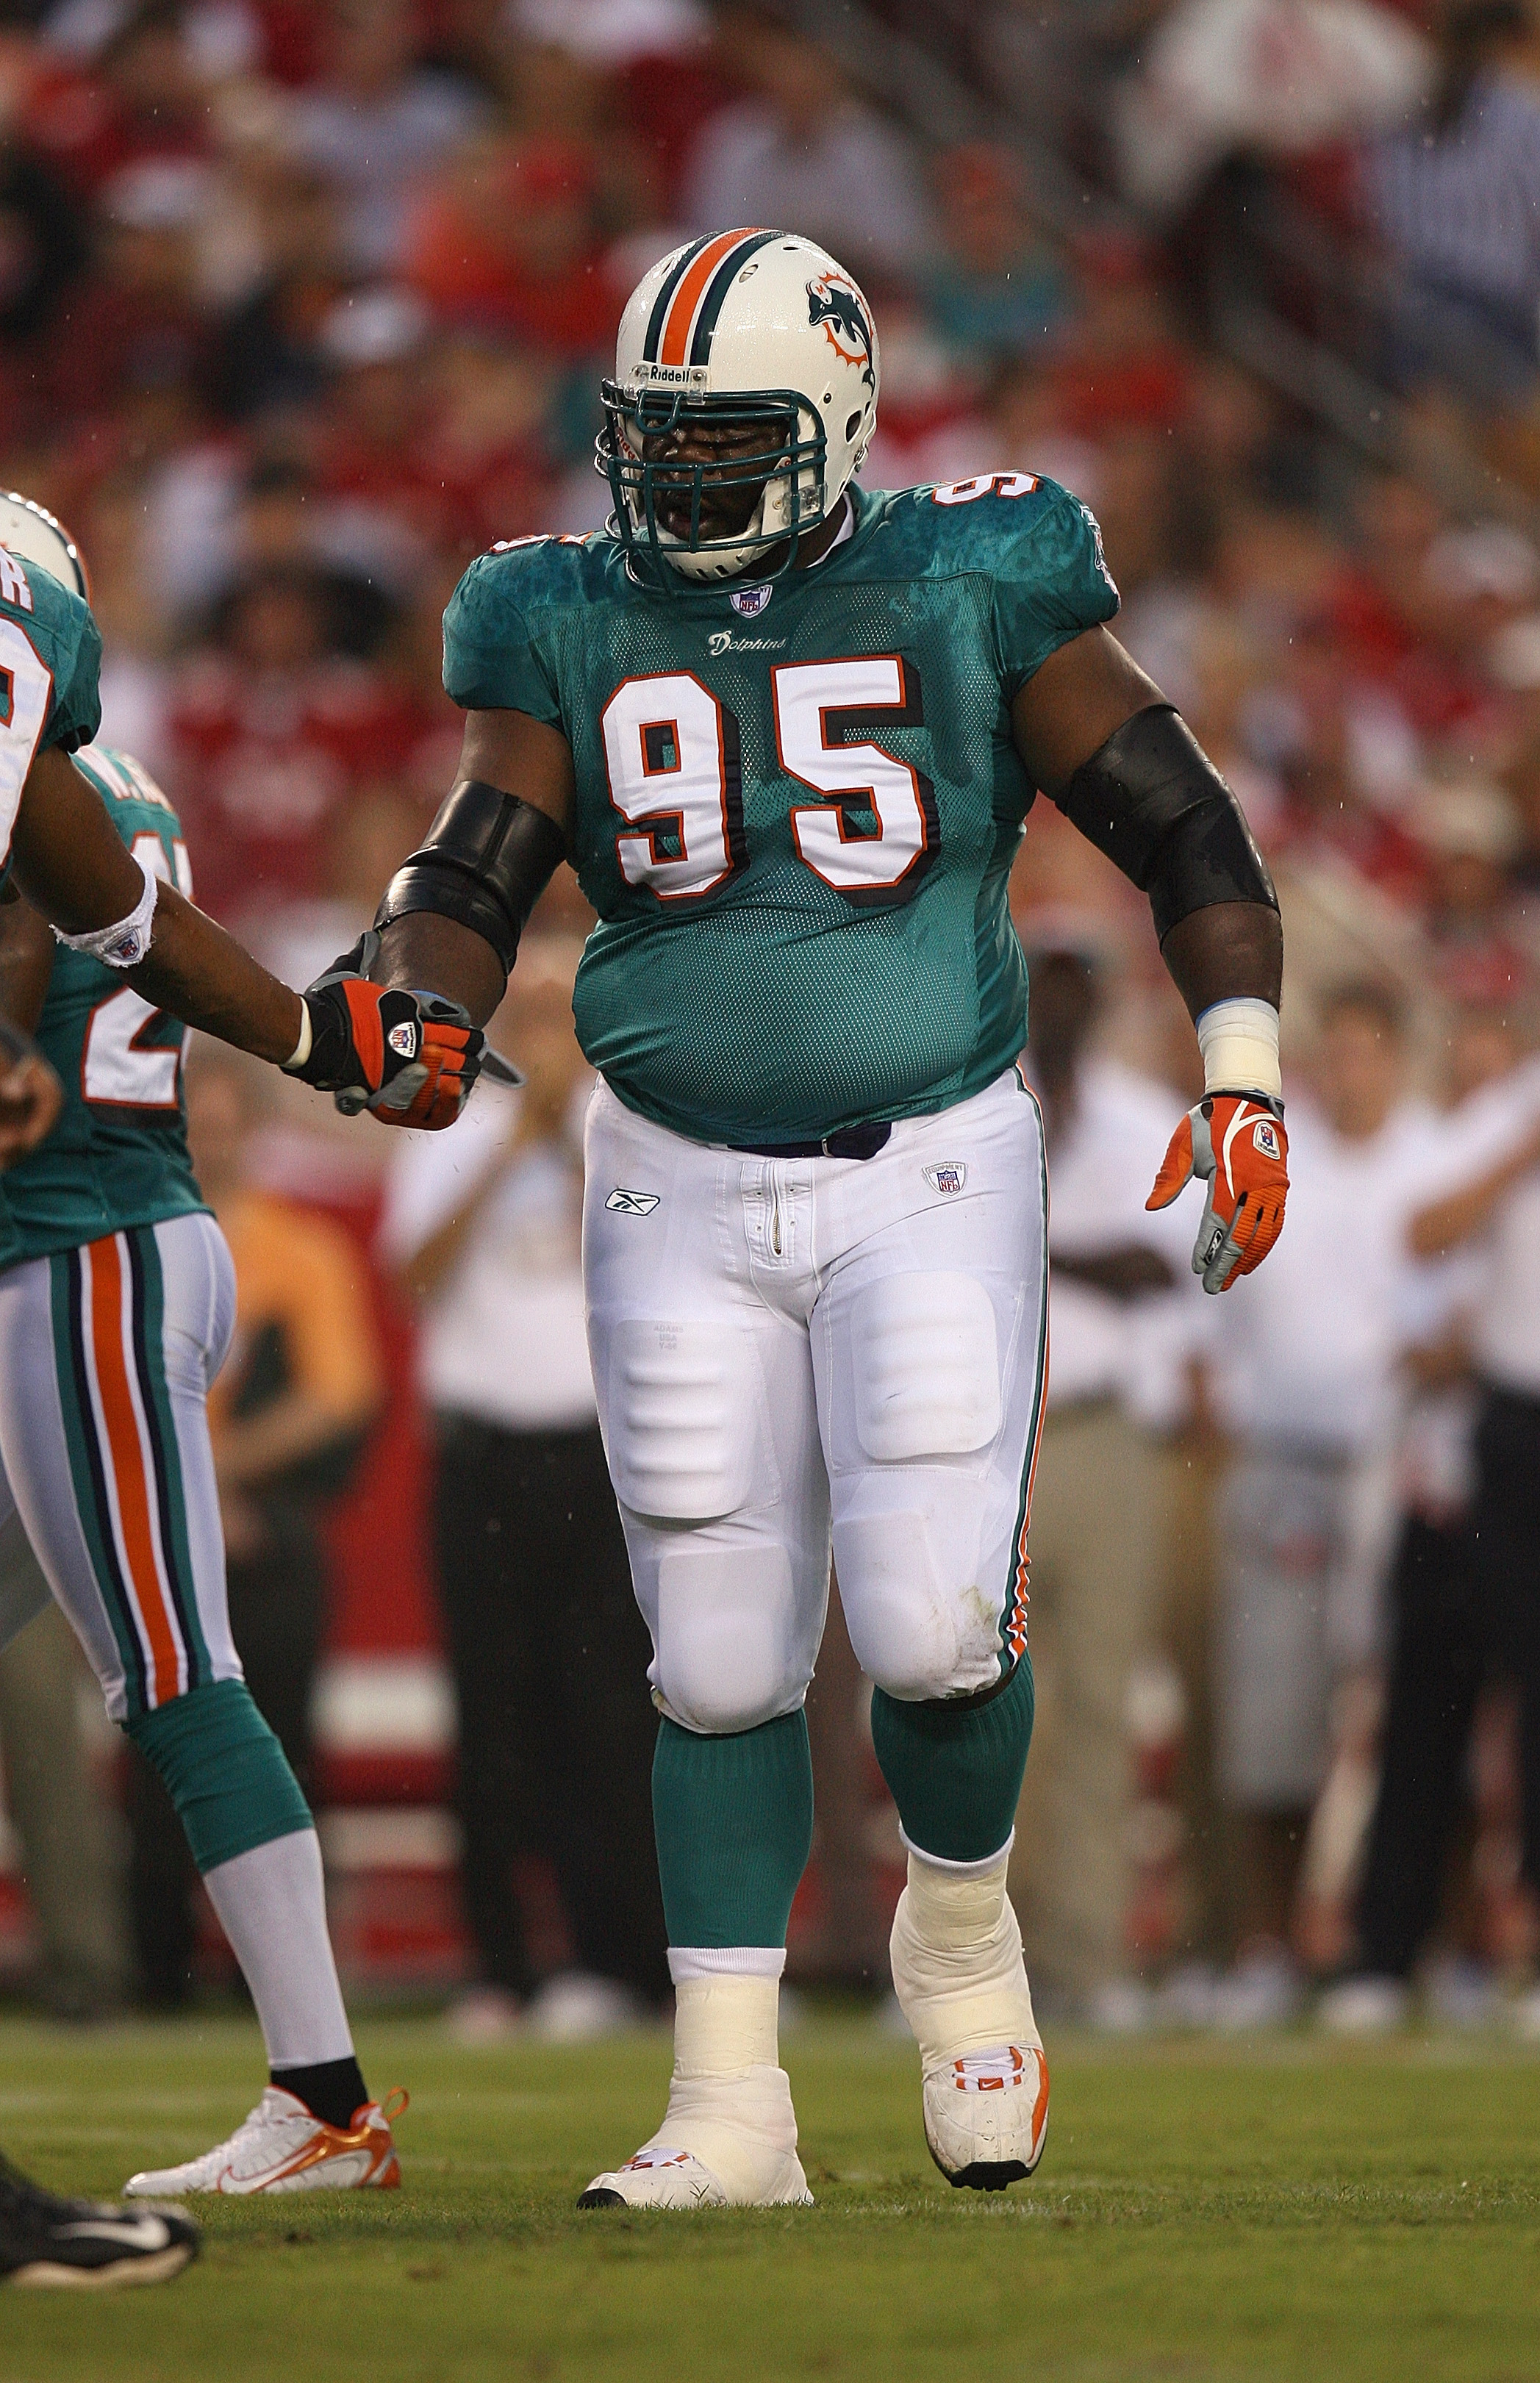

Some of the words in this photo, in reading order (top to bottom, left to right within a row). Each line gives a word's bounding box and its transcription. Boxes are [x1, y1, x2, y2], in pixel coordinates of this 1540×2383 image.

[815, 284, 826, 295] M
[651, 365, 690, 382] Riddell
[742, 601, 758, 611] NFL
[709, 630, 787, 656] Dolphins
[600, 654, 928, 901] 95
[940, 1180, 959, 1191] NFL
